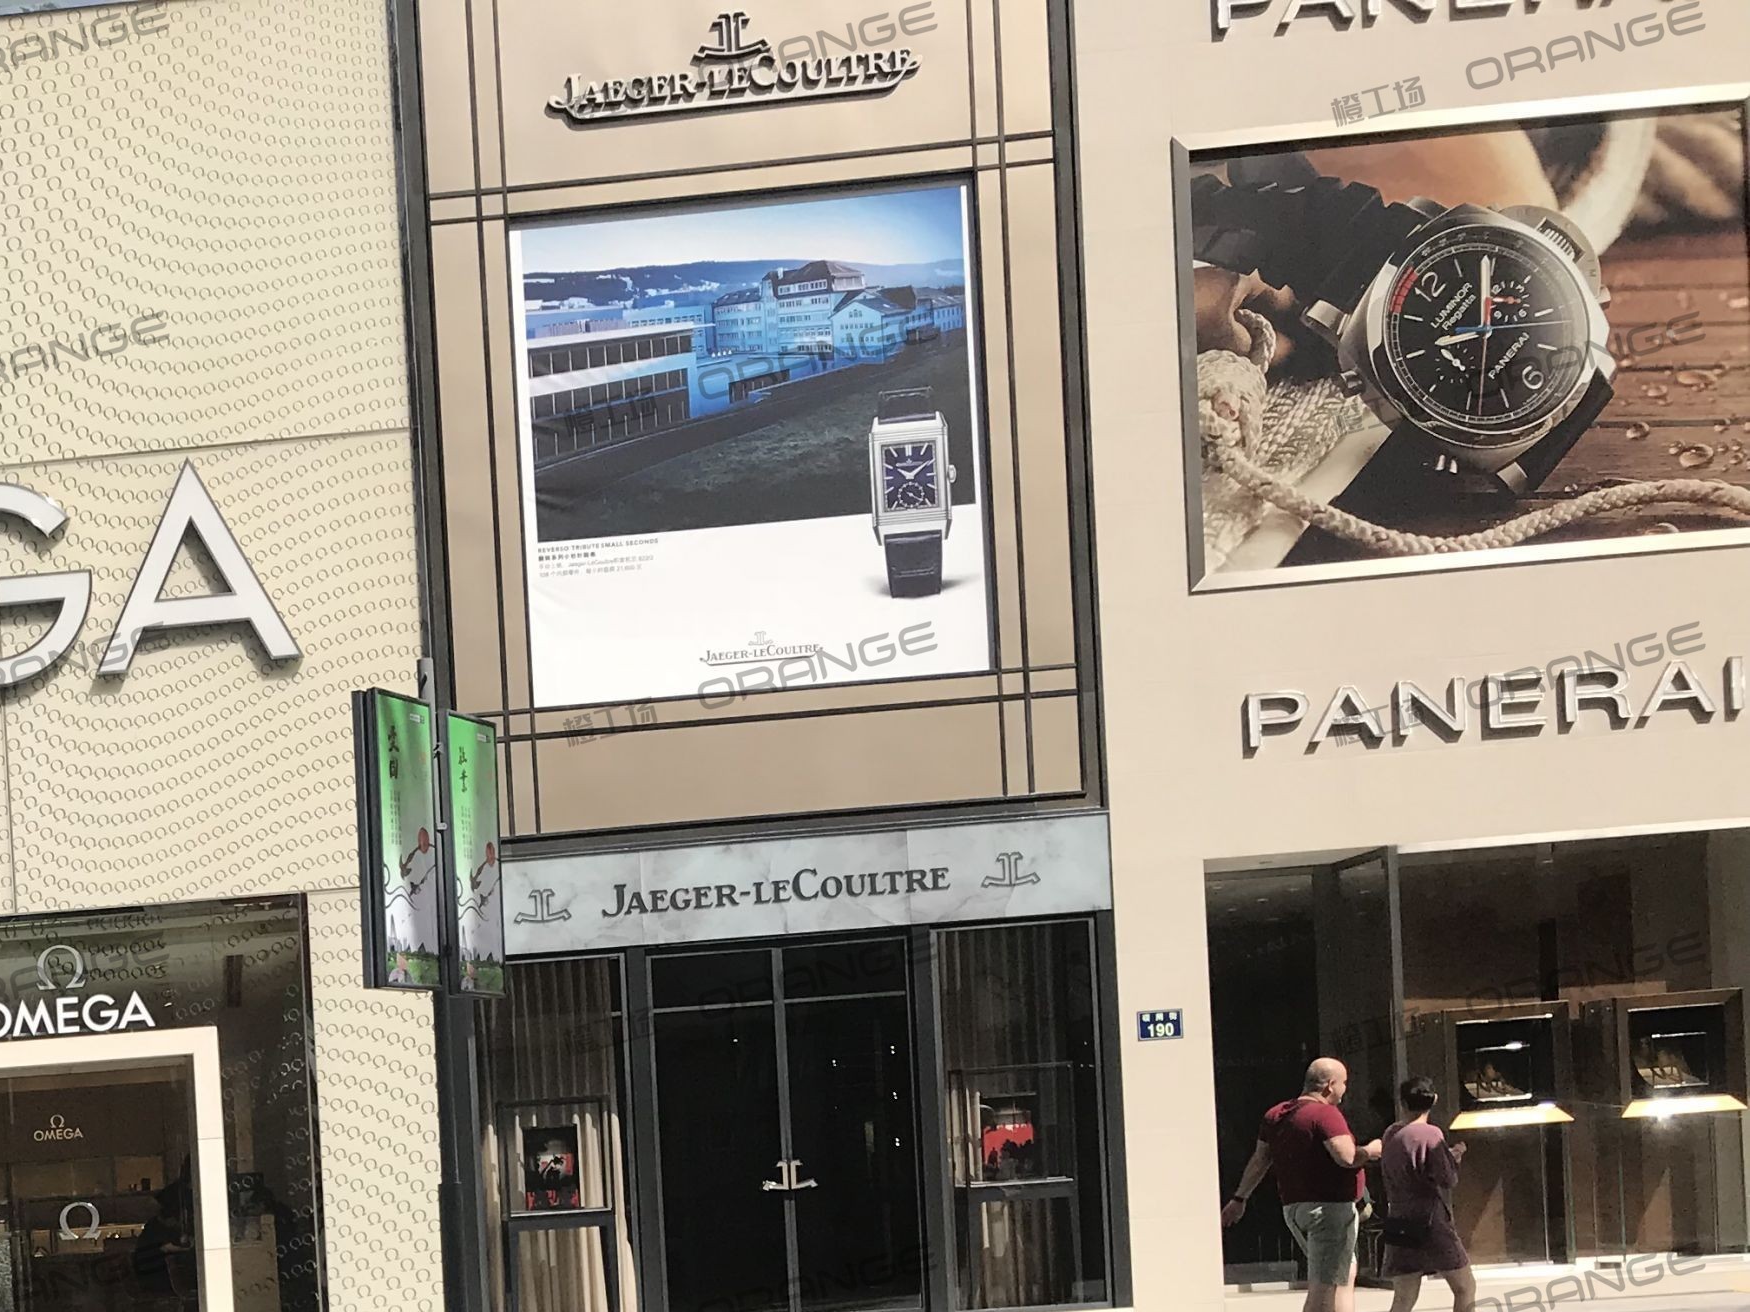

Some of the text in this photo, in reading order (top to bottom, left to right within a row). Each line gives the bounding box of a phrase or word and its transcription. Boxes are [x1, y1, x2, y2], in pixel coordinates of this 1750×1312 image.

[1430, 281, 1474, 329] LUMINOR
[1441, 293, 1477, 331] Regatta
[1488, 332, 1531, 380] PANERAI
[538, 537, 659, 553] REVERSO TRIBUTE SMALL SECONDS
[1242, 656, 1745, 759] PANERAI
[602, 867, 951, 918] JAEGER-LECOULTRE
[1147, 1022, 1175, 1038] 190
[33, 1127, 84, 1142] OMEGA
